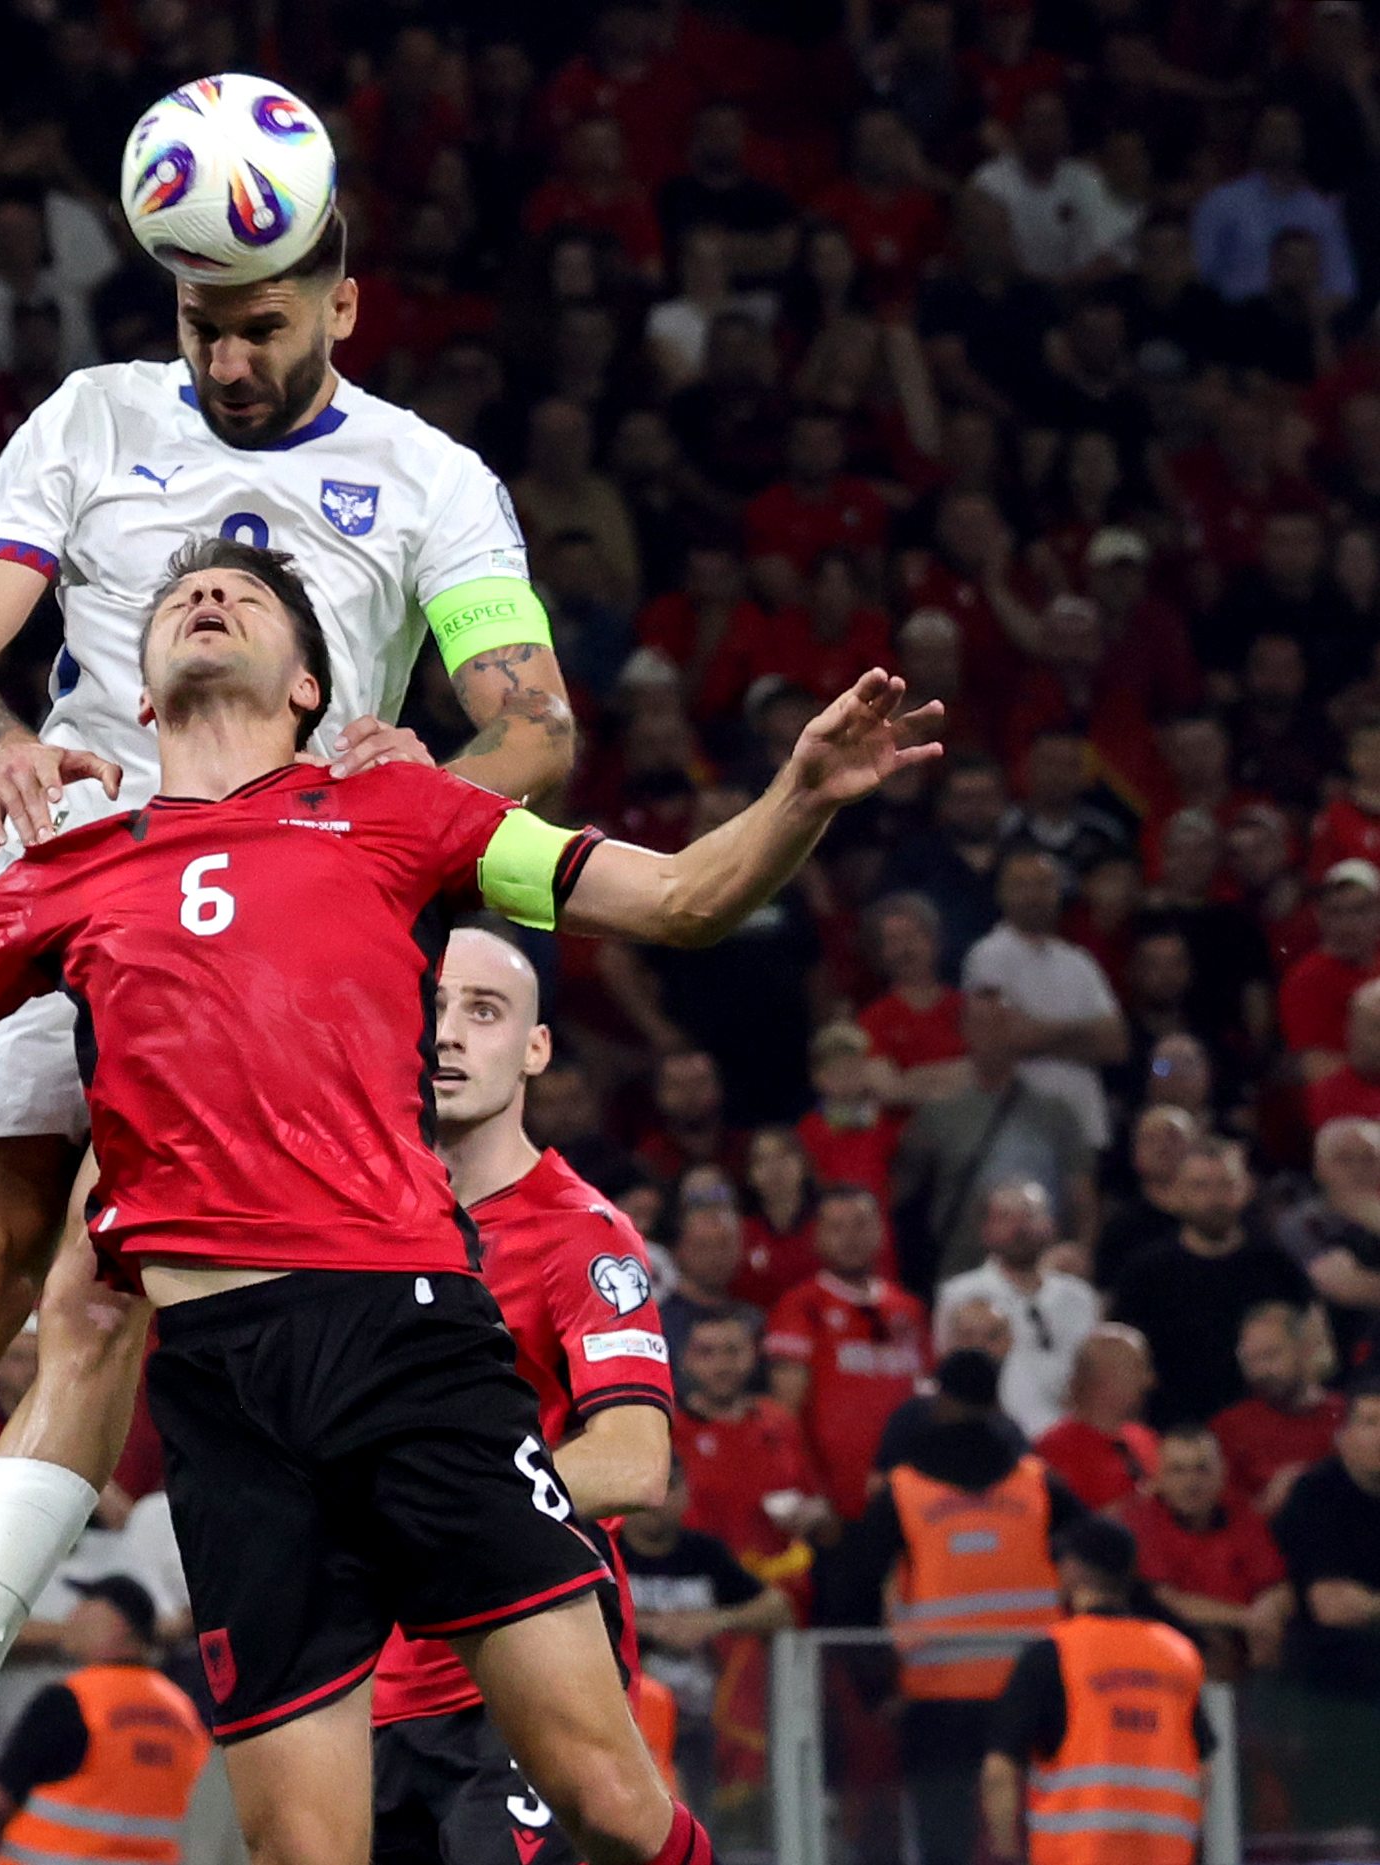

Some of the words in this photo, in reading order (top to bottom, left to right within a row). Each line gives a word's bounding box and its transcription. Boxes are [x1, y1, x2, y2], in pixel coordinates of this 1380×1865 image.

[443, 602, 517, 638] RESPECT
[180, 852, 236, 935] 6
[513, 1434, 570, 1522] 6
